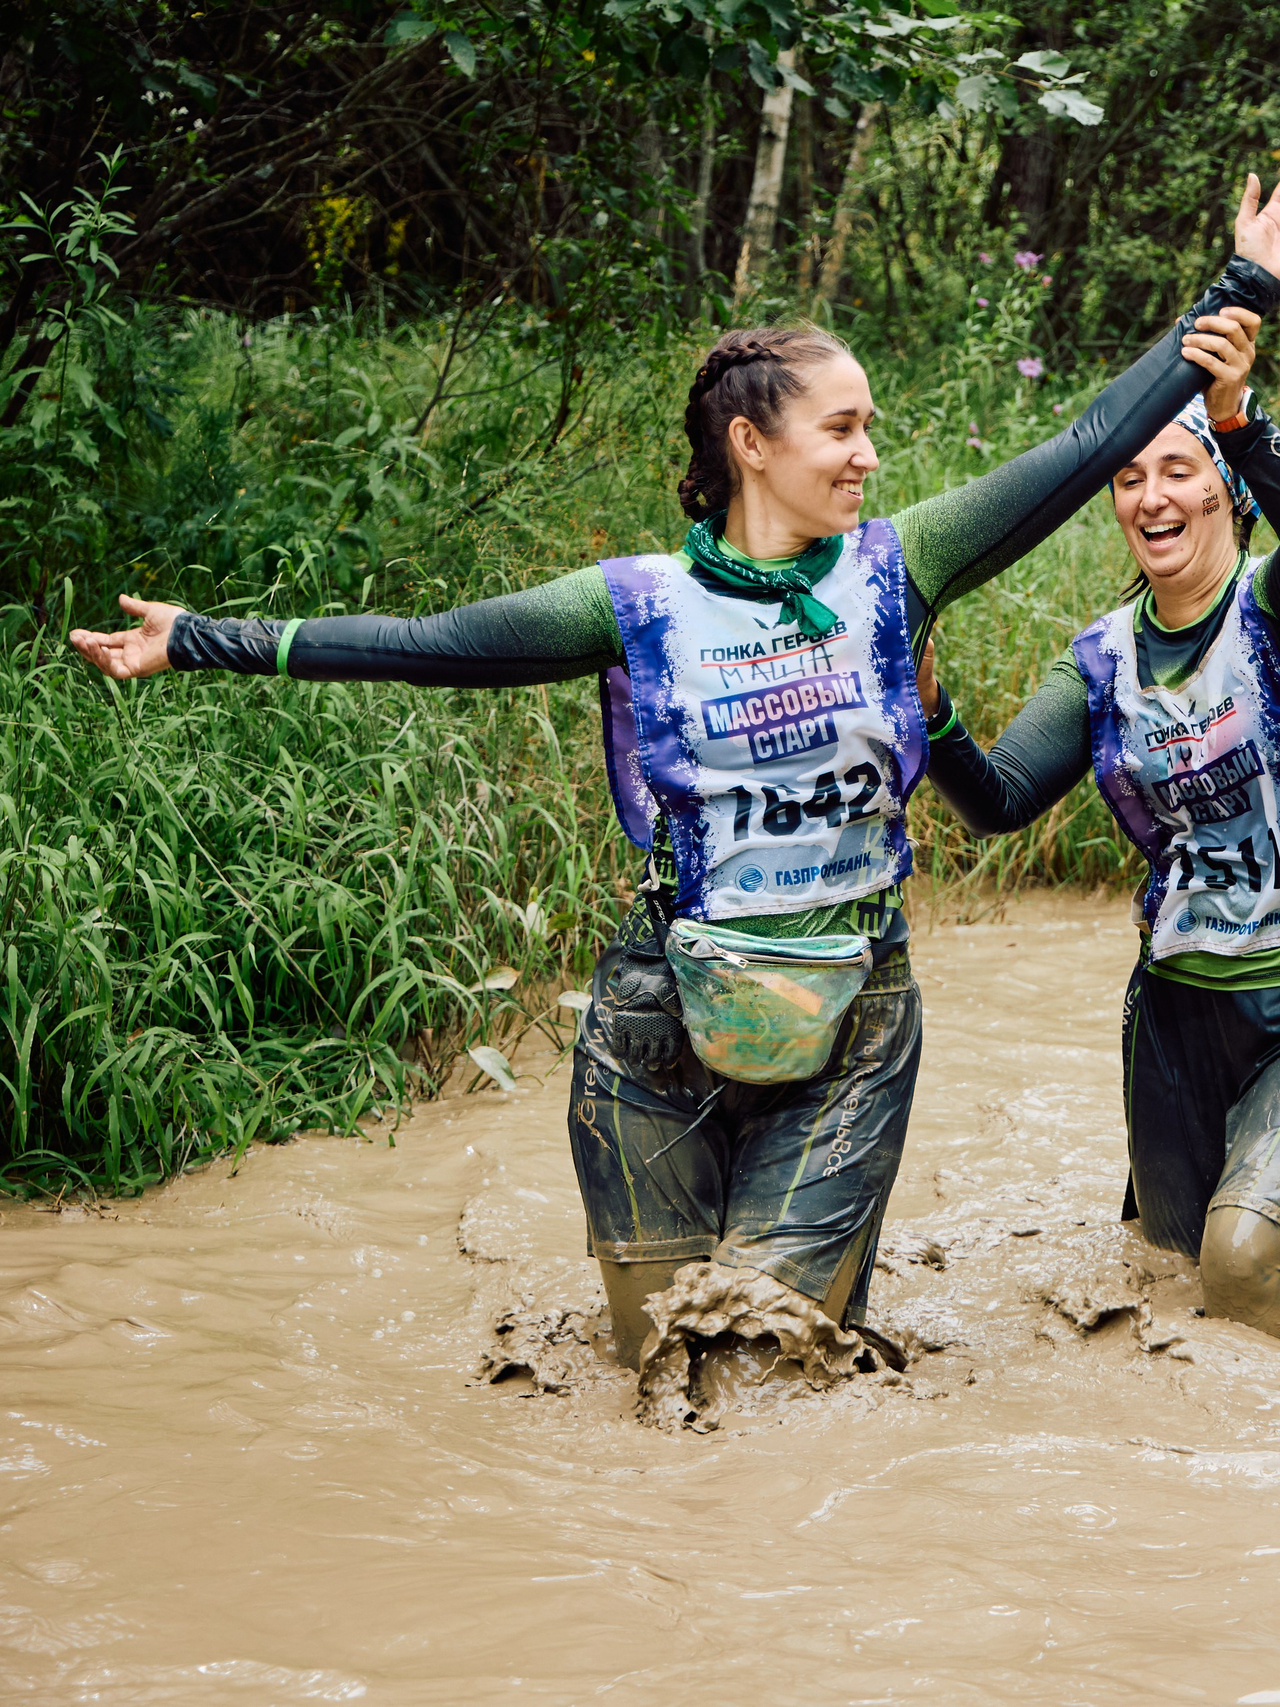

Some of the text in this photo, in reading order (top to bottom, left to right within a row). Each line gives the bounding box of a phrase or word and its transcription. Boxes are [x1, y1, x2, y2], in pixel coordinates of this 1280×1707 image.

[700, 641, 767, 662] ГОНКА
[708, 672, 862, 733] МАССОВЫЙ
[753, 713, 830, 759] СТАРТ
[727, 761, 882, 841] 1642
[1191, 789, 1247, 820] СТАРТ
[775, 851, 872, 886] ГАЗПРОМБАНК
